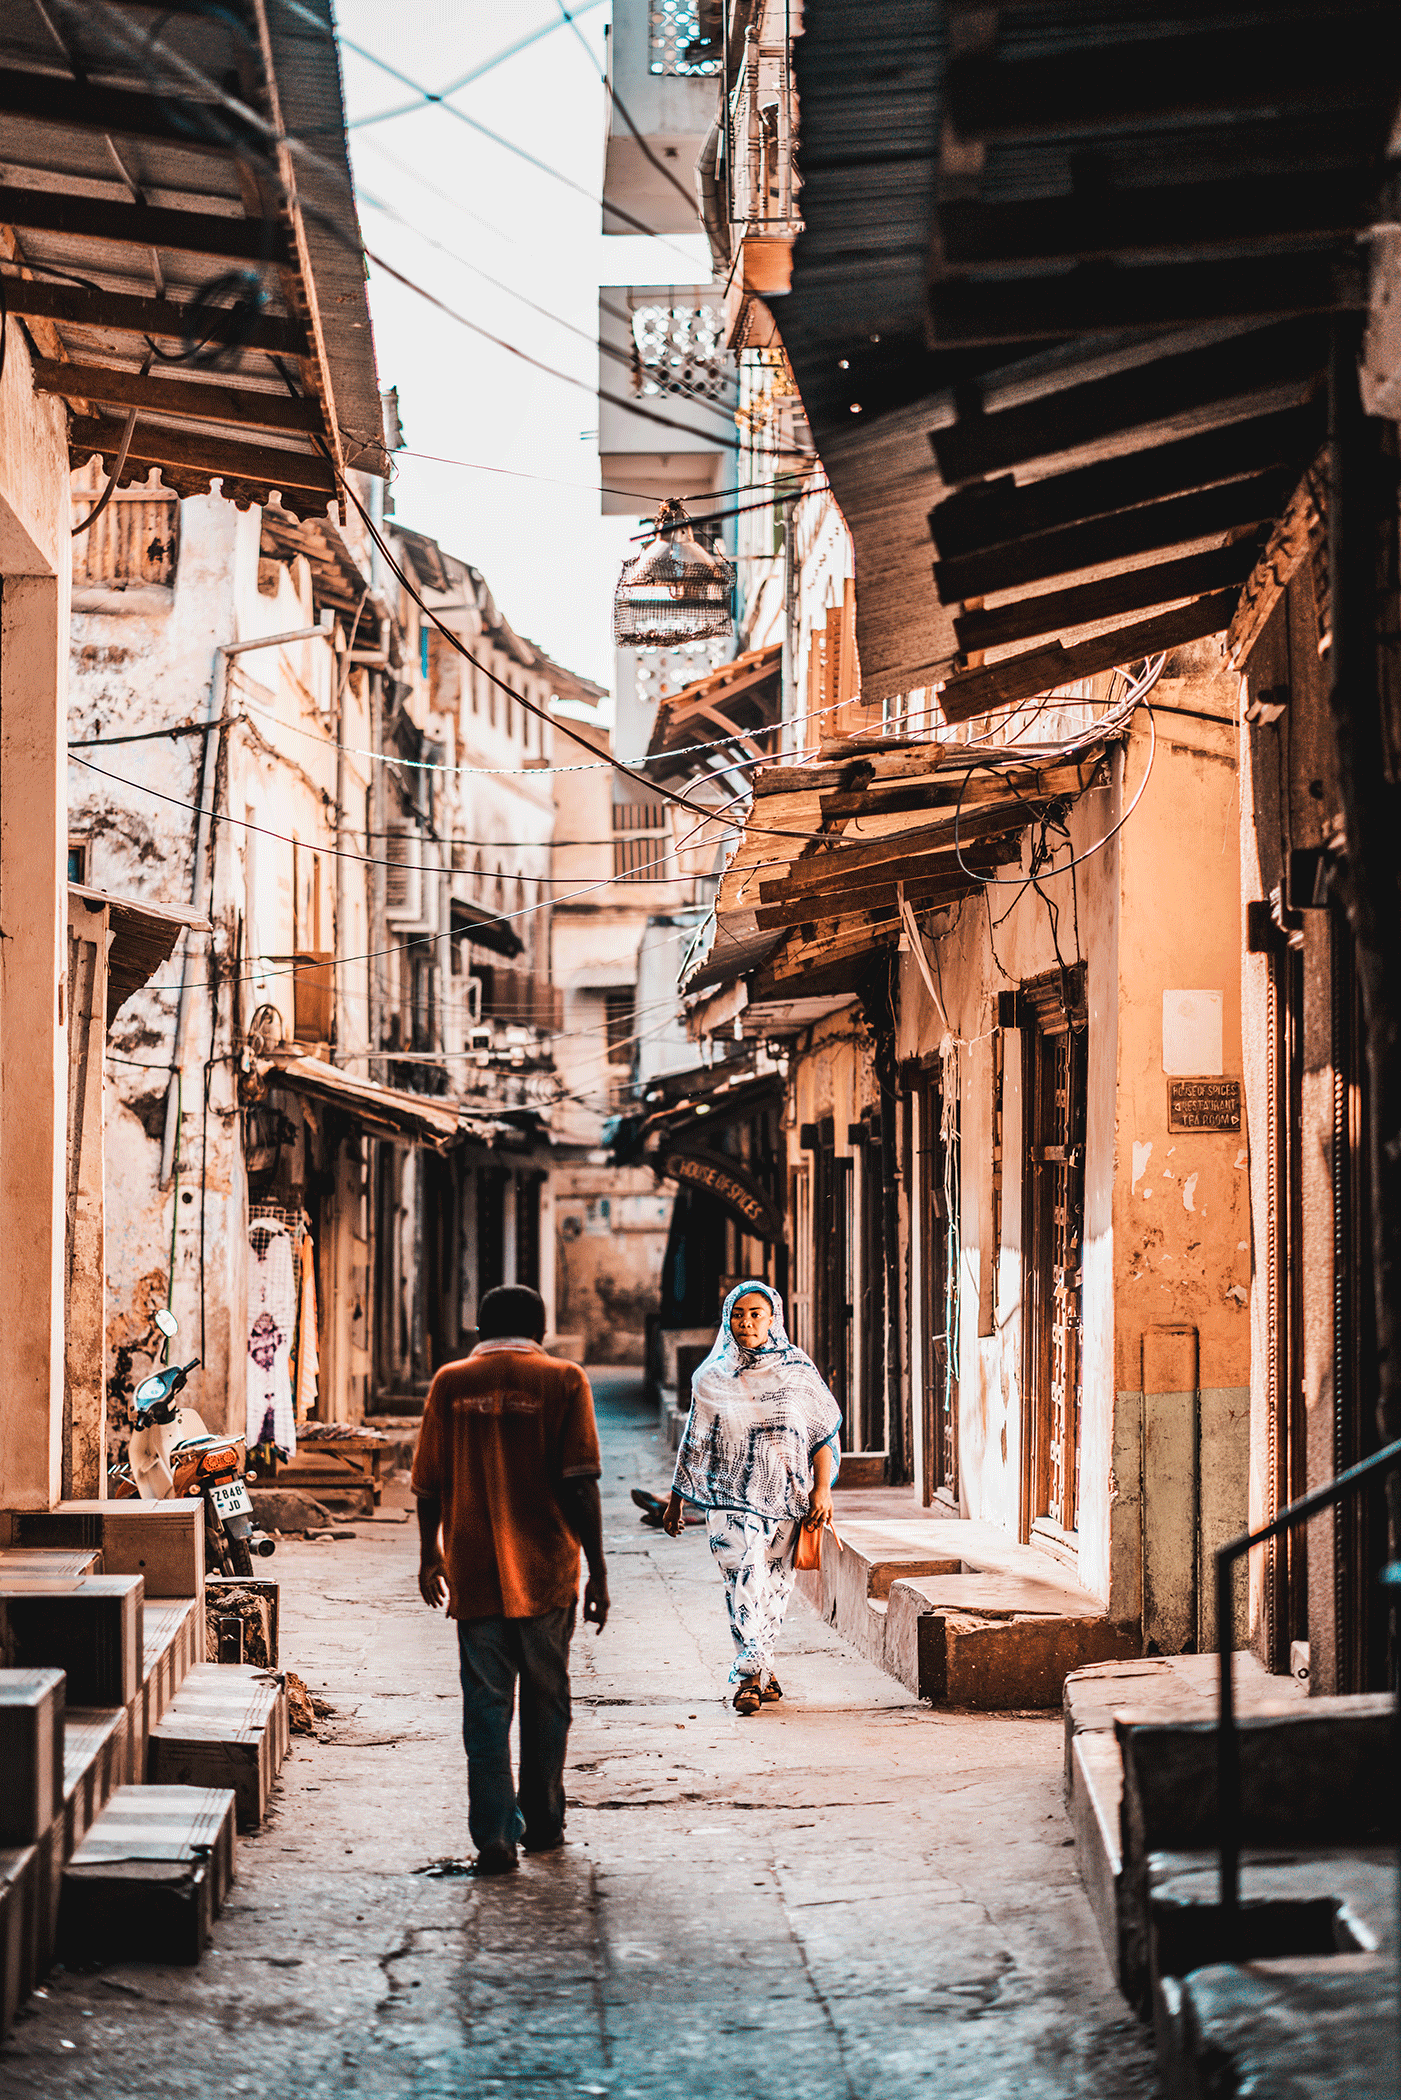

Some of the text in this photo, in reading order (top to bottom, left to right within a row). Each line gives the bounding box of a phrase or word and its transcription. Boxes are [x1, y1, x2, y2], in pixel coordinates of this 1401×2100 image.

[1207, 1084, 1237, 1096] SPICES
[1182, 1099, 1235, 1112] RESTAURANT
[1182, 1114, 1229, 1126] TEA ROOM
[679, 1160, 763, 1219] HOUSE OF SPICES
[214, 1485, 242, 1502] Z848
[228, 1499, 241, 1512] JD
